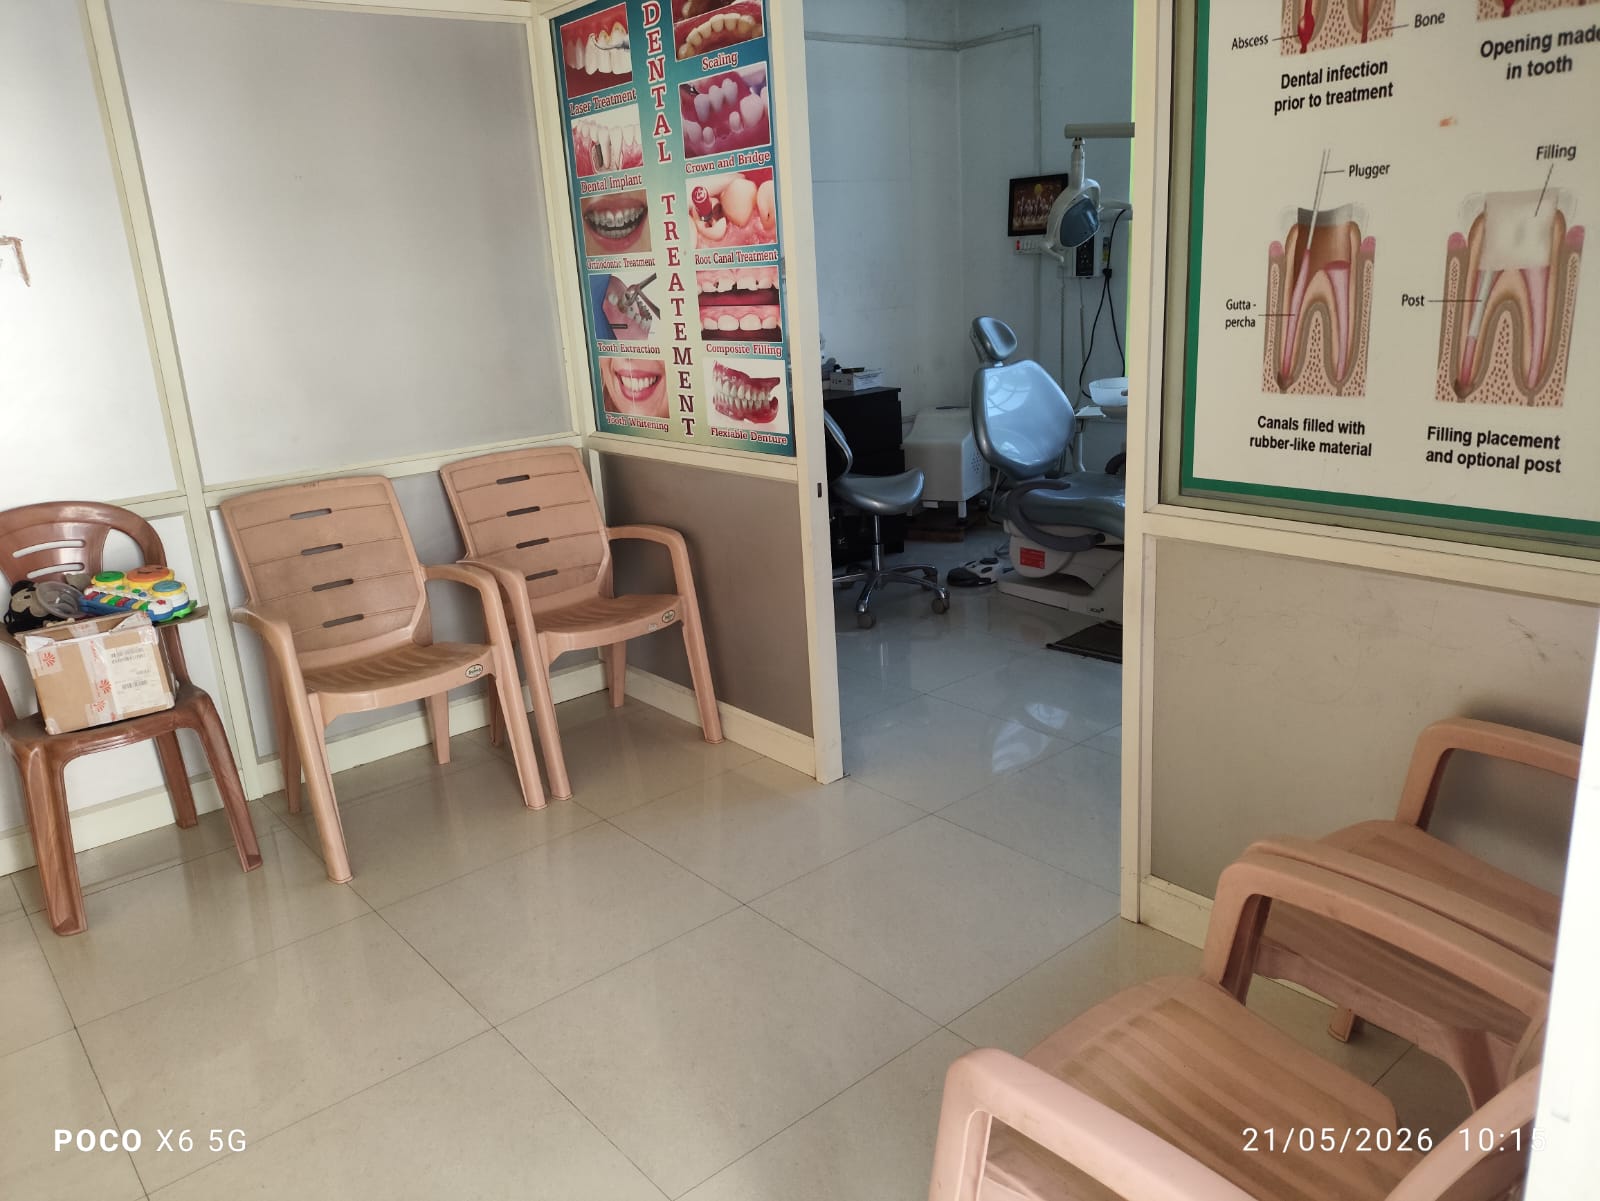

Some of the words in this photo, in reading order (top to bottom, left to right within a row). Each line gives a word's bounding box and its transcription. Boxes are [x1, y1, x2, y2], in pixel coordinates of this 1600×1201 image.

[1414, 12, 1446, 29] Bone
[1232, 34, 1269, 50] Abscess
[1480, 32, 1552, 58] Opening
[702, 52, 738, 70] Scaling
[1506, 63, 1522, 80] in
[1527, 56, 1573, 77] tooth
[643, 2, 672, 163] DENTAL
[1281, 68, 1323, 89] Dental
[1326, 60, 1389, 82] infection
[569, 101, 591, 116] Laser
[593, 89, 637, 109] Treatment
[1274, 95, 1305, 116] prior
[1308, 93, 1323, 108] to
[1325, 82, 1394, 105] treatment
[1536, 144, 1577, 162] Filling
[686, 161, 716, 174] Crown
[717, 157, 736, 169] and
[738, 151, 771, 168] Bridge
[1348, 163, 1391, 180] Plugger
[581, 178, 608, 193] Dental
[609, 174, 643, 191] Implant
[623, 257, 657, 268] Treatment
[695, 253, 712, 265] Root
[713, 252, 735, 264] Canal
[736, 249, 778, 262] Treatment
[1401, 294, 1425, 307] Post
[661, 194, 696, 436] TREATMENT
[1225, 317, 1256, 330] percha
[598, 342, 618, 353] Tooth
[620, 343, 661, 354] Extraction
[706, 343, 751, 356] Composite
[752, 344, 783, 357] Filling
[607, 415, 628, 426] Tooth
[629, 417, 670, 433] Whitening
[1257, 415, 1299, 431] Canals
[1303, 418, 1334, 433] filled
[1337, 420, 1366, 435] with
[711, 427, 749, 440] Flexiable
[750, 432, 788, 445] Denture
[1427, 426, 1472, 446] Filling
[1477, 430, 1561, 450] placement
[1250, 435, 1316, 452] rubber-like
[1319, 440, 1372, 457] material
[1425, 448, 1453, 463] and
[1457, 450, 1520, 470] optional
[1524, 457, 1562, 474] post
